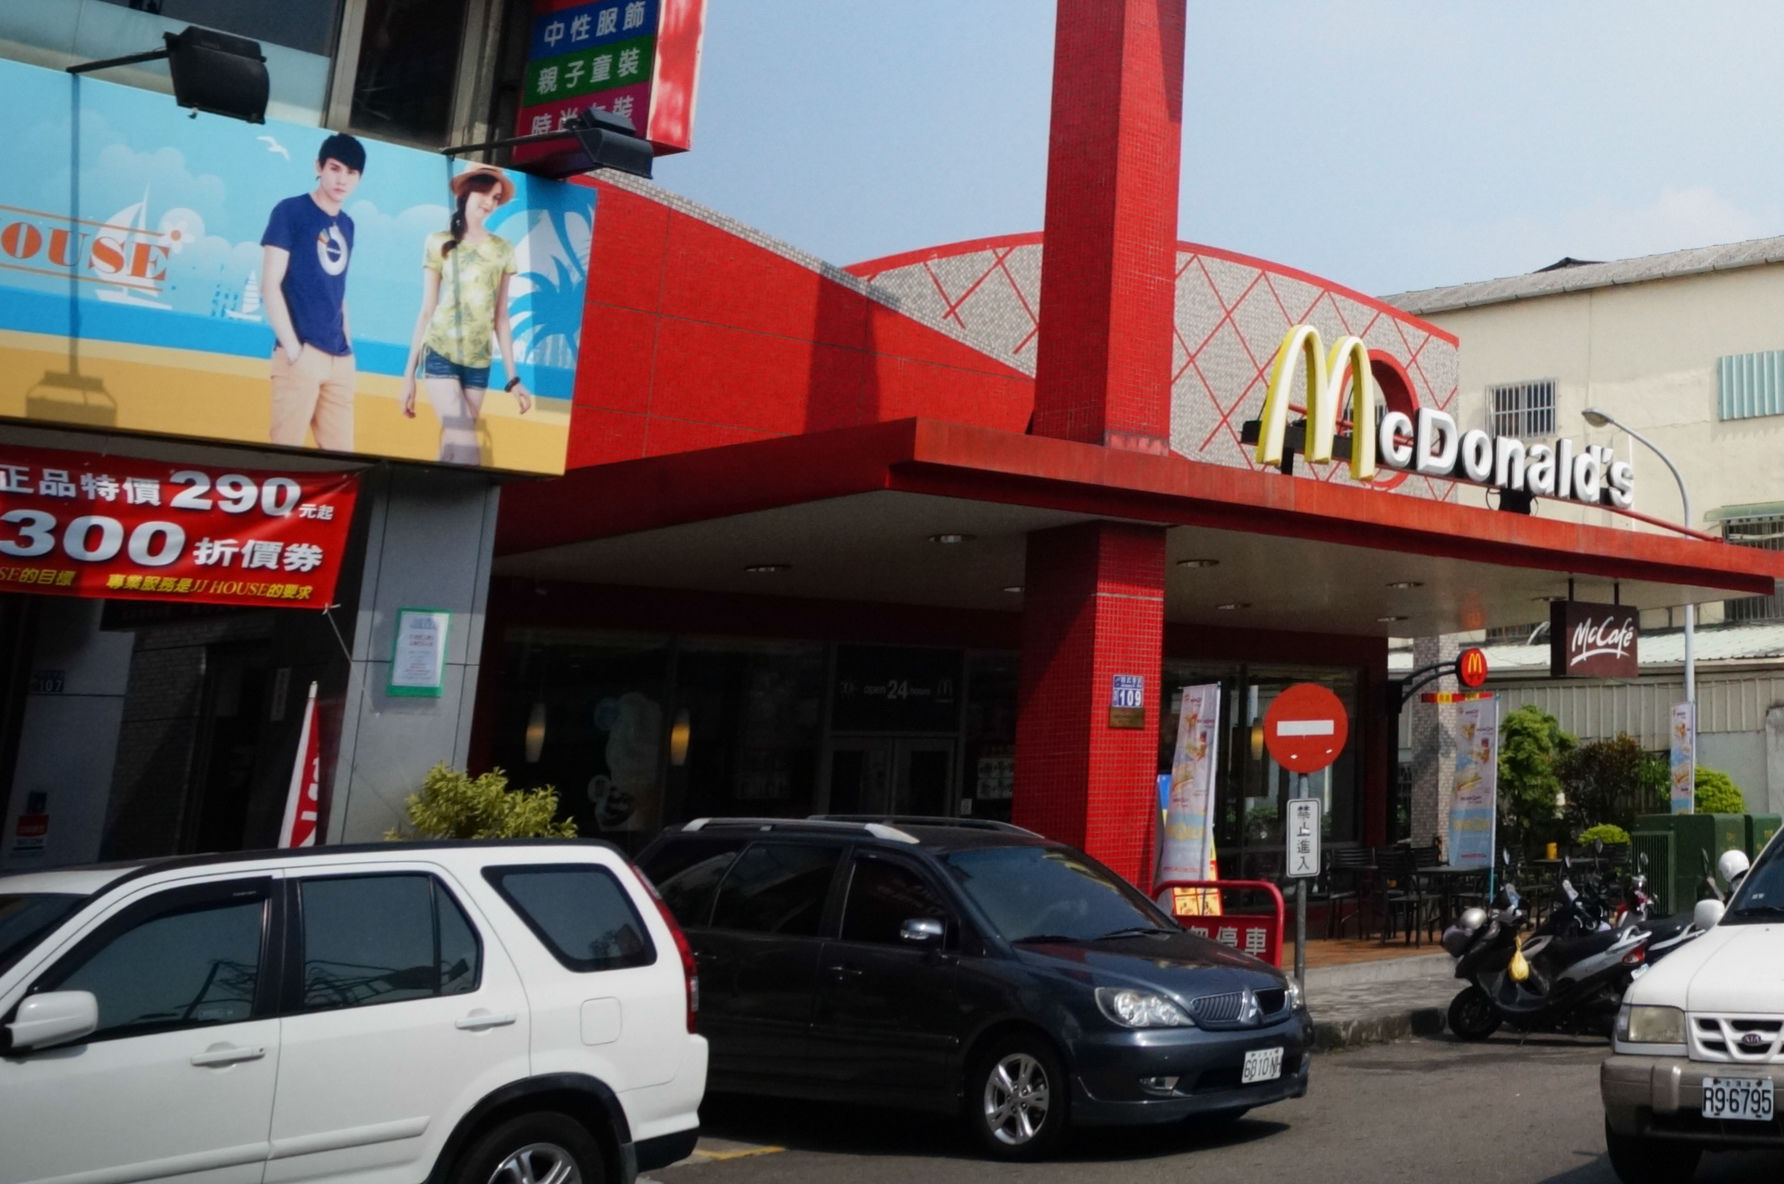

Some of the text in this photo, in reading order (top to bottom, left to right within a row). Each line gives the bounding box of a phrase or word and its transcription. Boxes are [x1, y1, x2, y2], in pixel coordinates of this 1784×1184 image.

[543, 0, 647, 48] 中性服飾
[536, 47, 641, 96] 親子童裝
[1, 221, 171, 282] OUSE
[0, 463, 335, 522] 正品特價 290 元起
[0, 508, 324, 574] 300 折價券
[1569, 616, 1635, 658] McCafé
[1118, 689, 1142, 708] 109
[1296, 804, 1311, 872] 禁止進入
